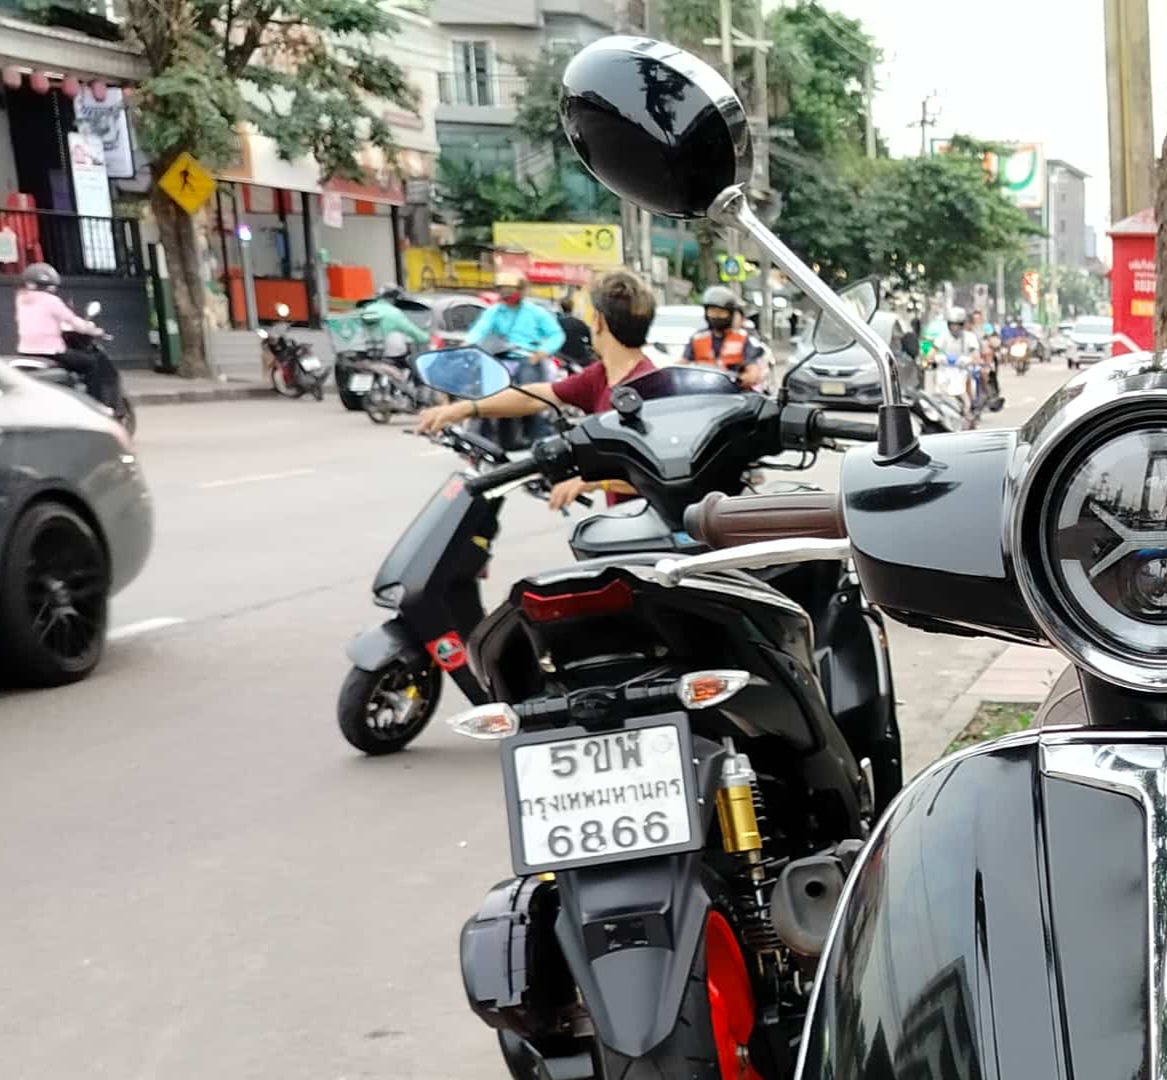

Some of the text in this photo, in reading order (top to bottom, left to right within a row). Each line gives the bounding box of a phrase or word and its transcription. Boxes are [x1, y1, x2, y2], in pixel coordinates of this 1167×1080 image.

[521, 778, 681, 821] กรุงเทพมหานคร
[547, 811, 670, 857] 6866
